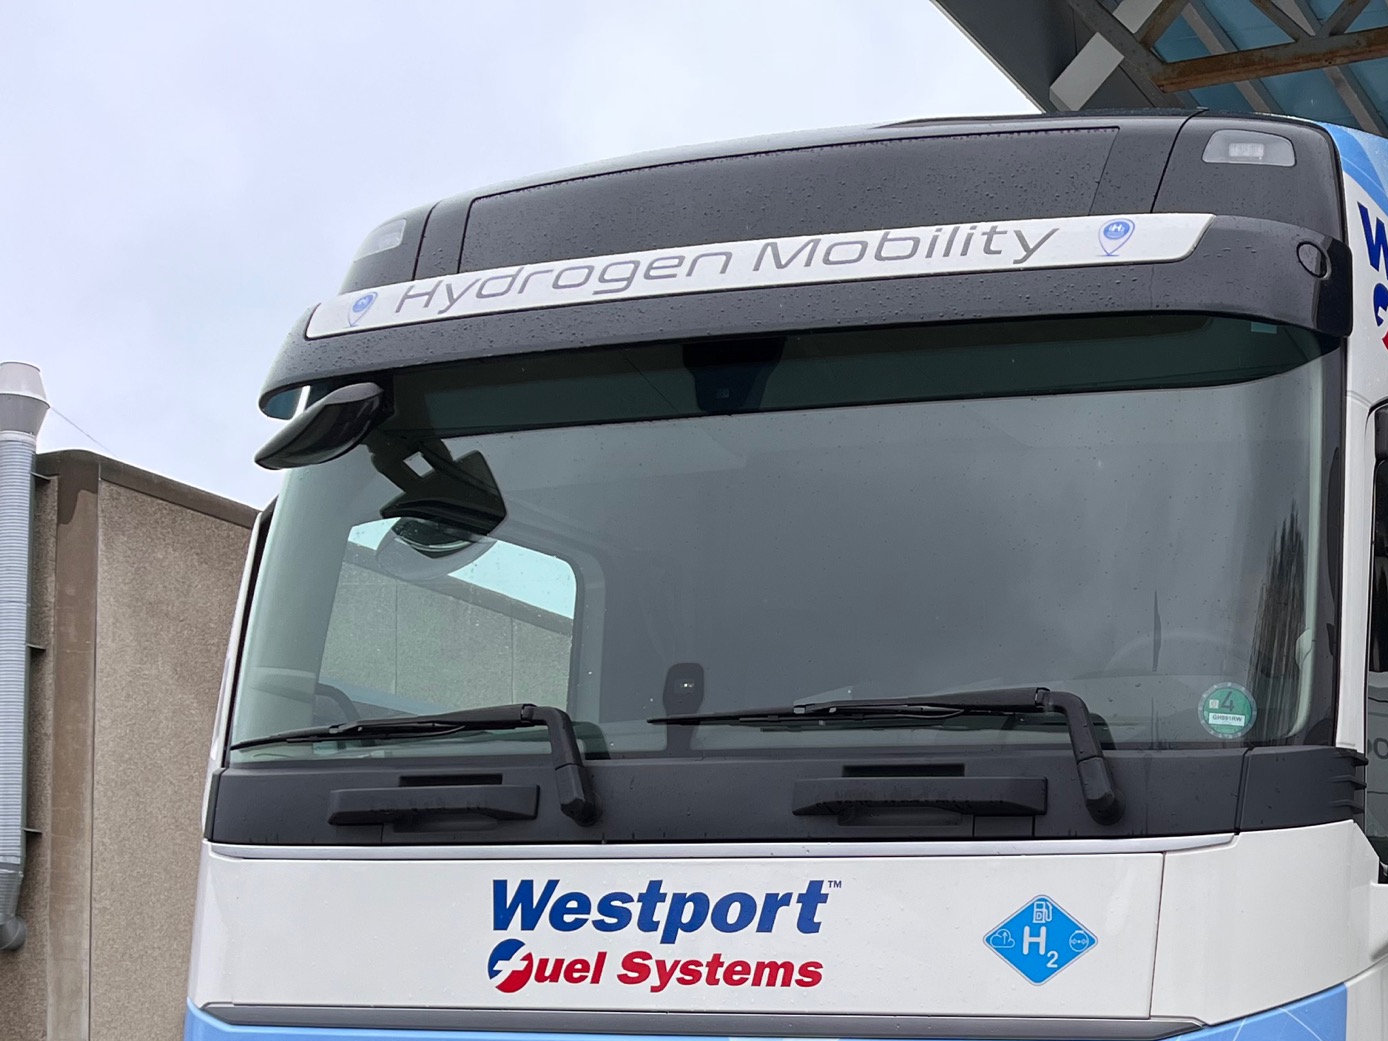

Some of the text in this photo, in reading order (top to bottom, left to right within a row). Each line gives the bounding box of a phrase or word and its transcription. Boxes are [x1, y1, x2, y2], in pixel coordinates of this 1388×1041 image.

[395, 225, 1060, 315] Hydrogen Mobility
[1220, 690, 1235, 712] 4
[492, 878, 830, 945] Westport
[616, 949, 824, 994] Systems
